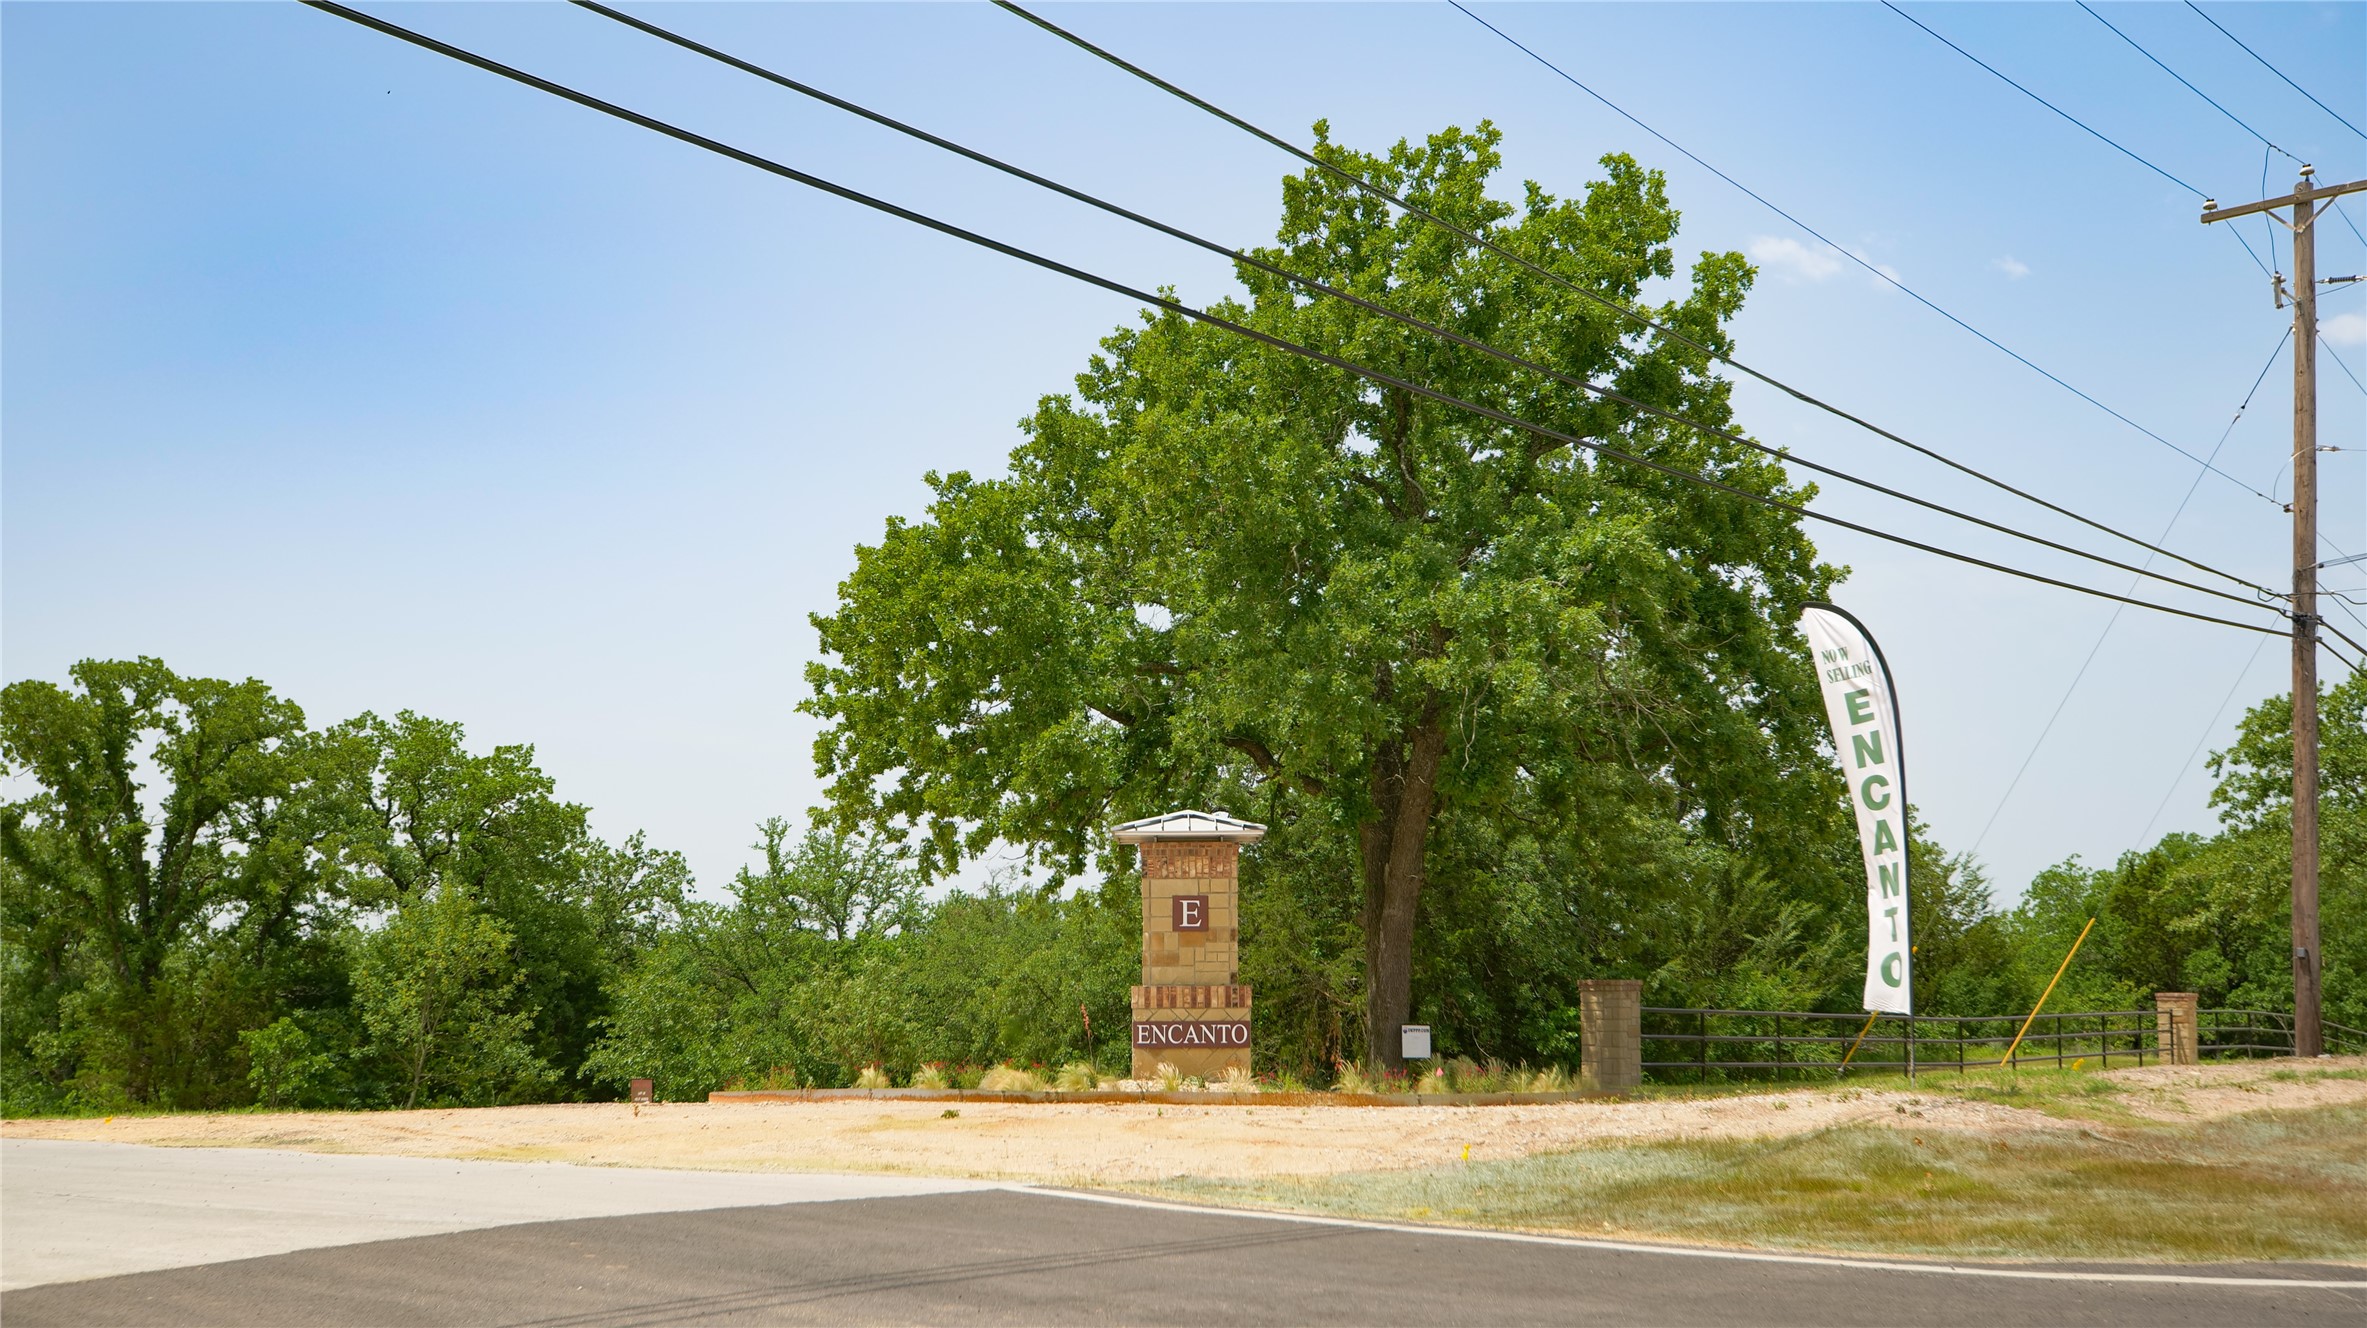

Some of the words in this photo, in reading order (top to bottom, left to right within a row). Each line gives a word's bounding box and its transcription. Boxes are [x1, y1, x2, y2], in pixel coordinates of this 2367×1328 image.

[1821, 646, 1849, 665] NOW
[1826, 660, 1872, 684] SELLING
[1844, 688, 1902, 988] ENCANTO
[1179, 900, 1202, 928] E
[1136, 1023, 1249, 1045] ENCANTO
